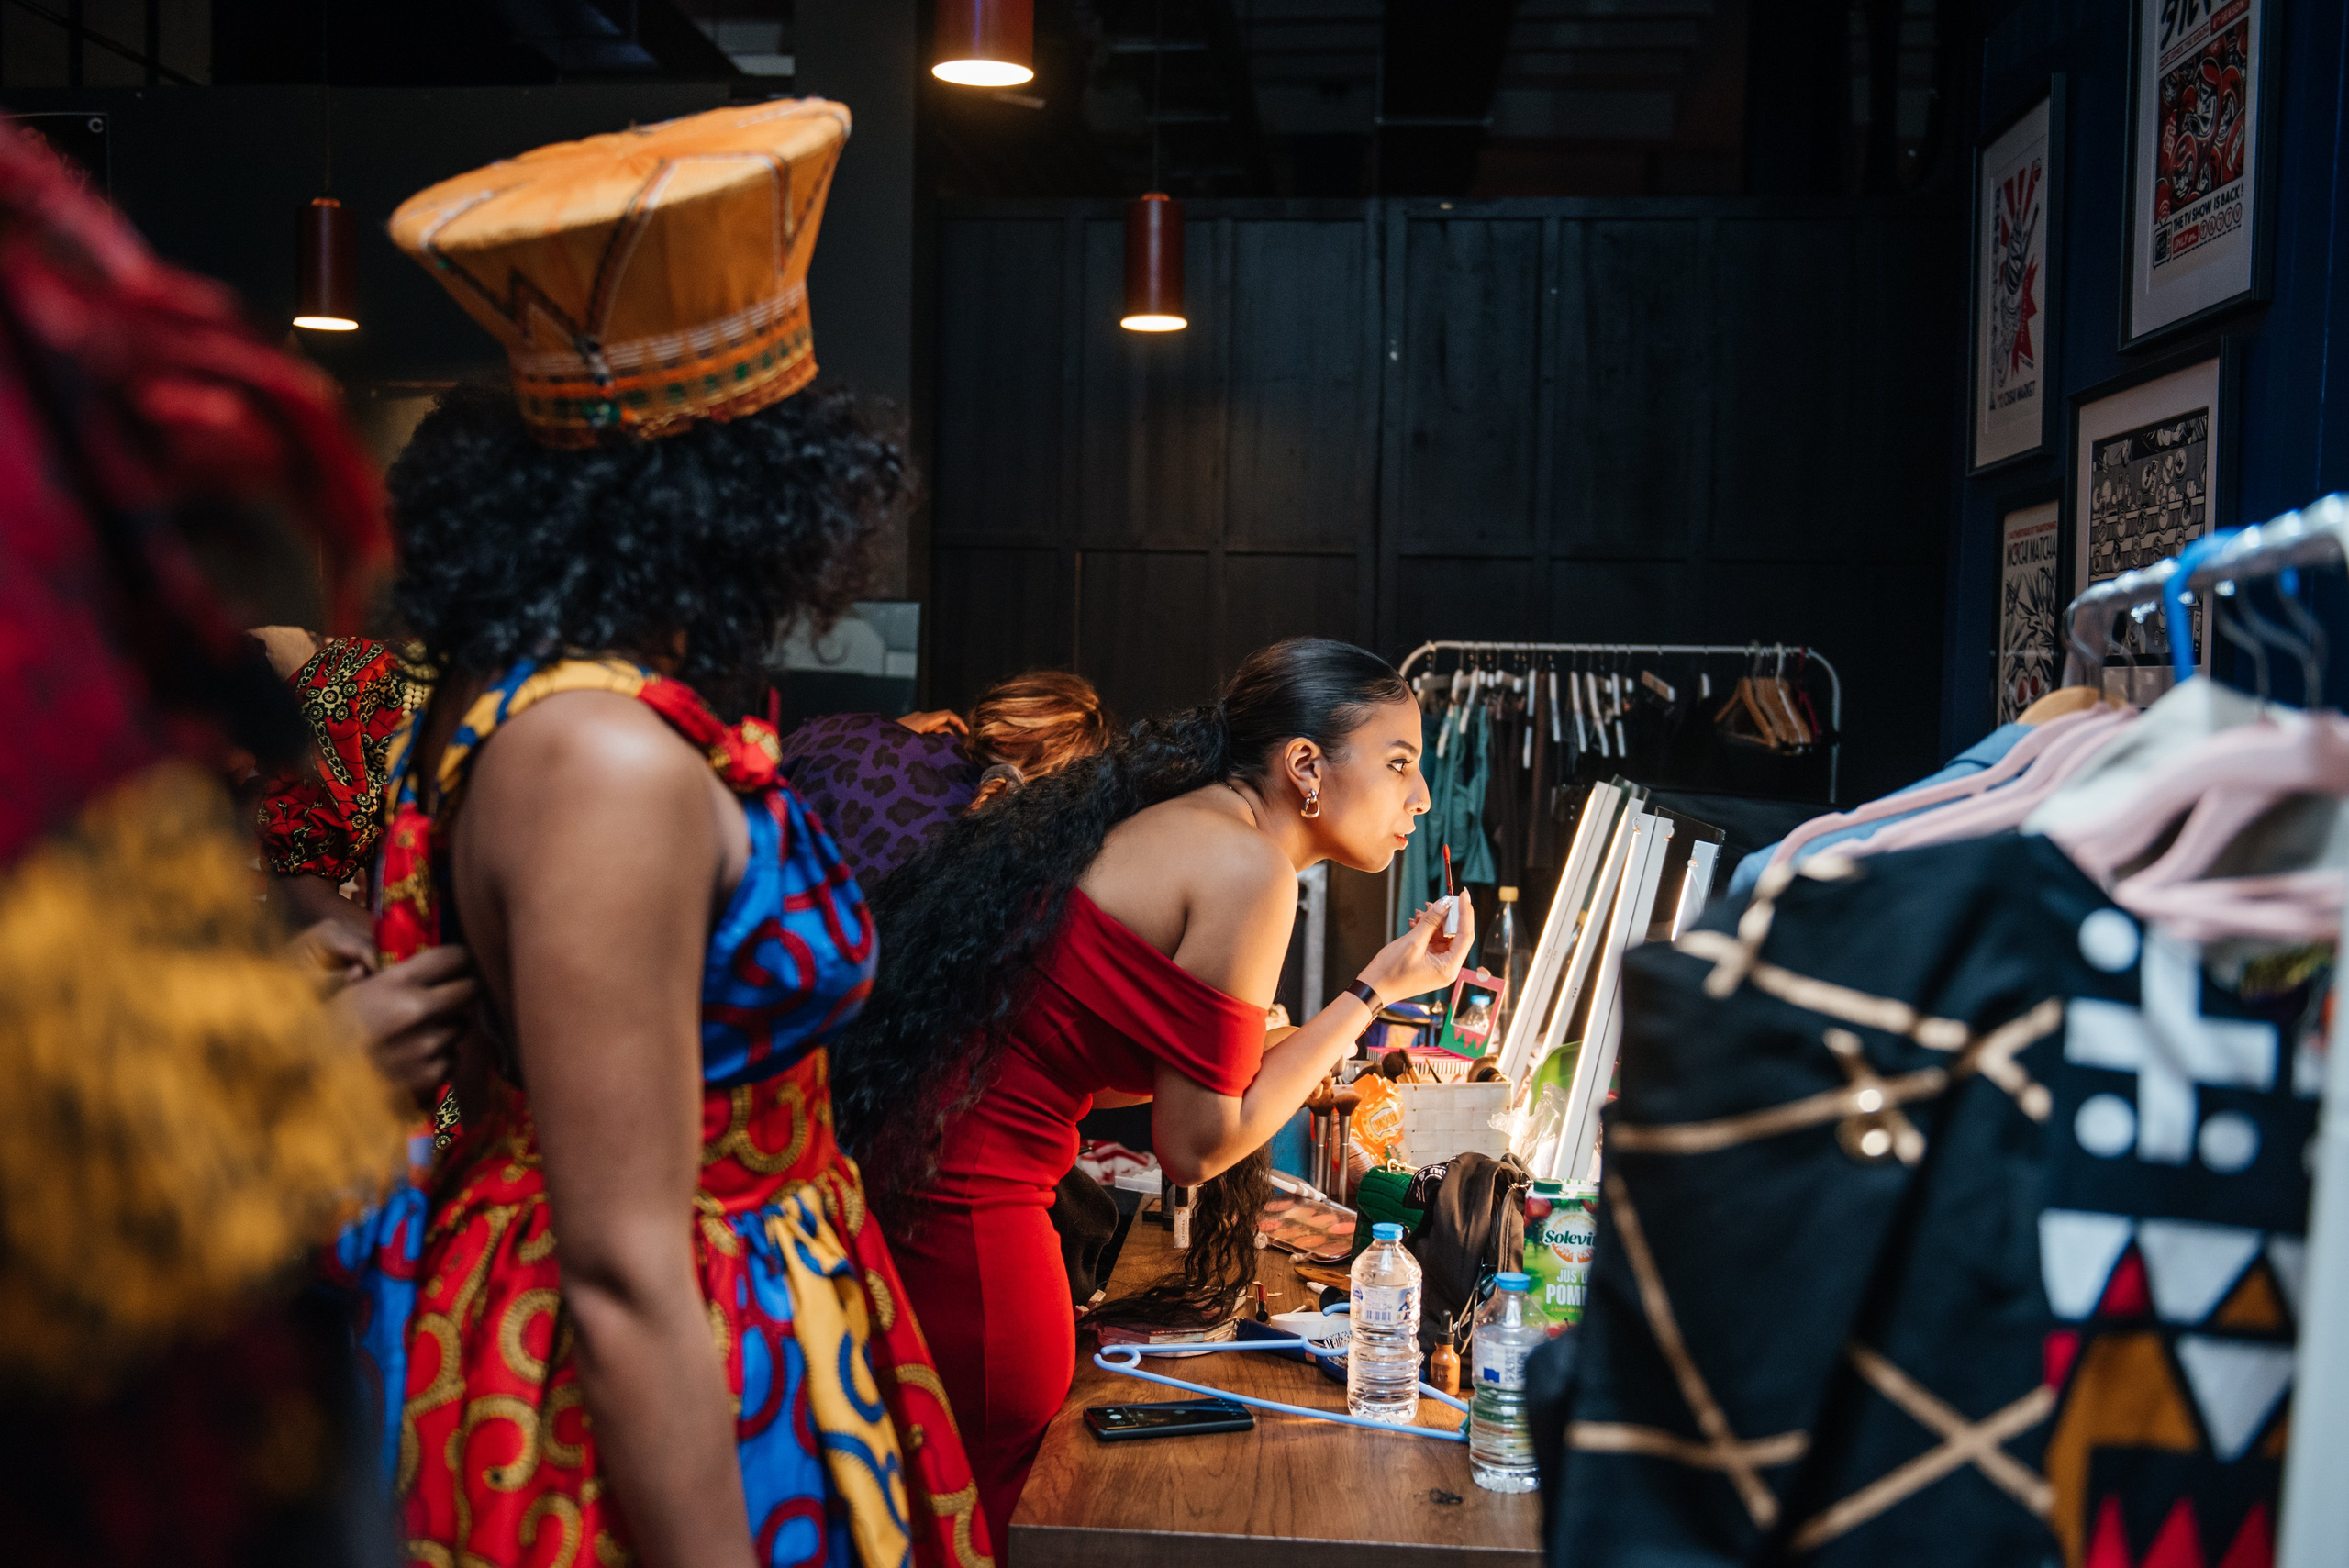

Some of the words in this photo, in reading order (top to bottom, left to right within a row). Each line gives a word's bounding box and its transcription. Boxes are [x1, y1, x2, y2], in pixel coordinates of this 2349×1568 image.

[2173, 215, 2183, 232] THE
[2184, 211, 2192, 226] TV
[2192, 199, 2212, 222] SHOW
[2213, 195, 2221, 211] IS
[2029, 535, 2056, 563] MATCHA
[1556, 1268, 1577, 1284] JUS
[1581, 1270, 1588, 1284] D
